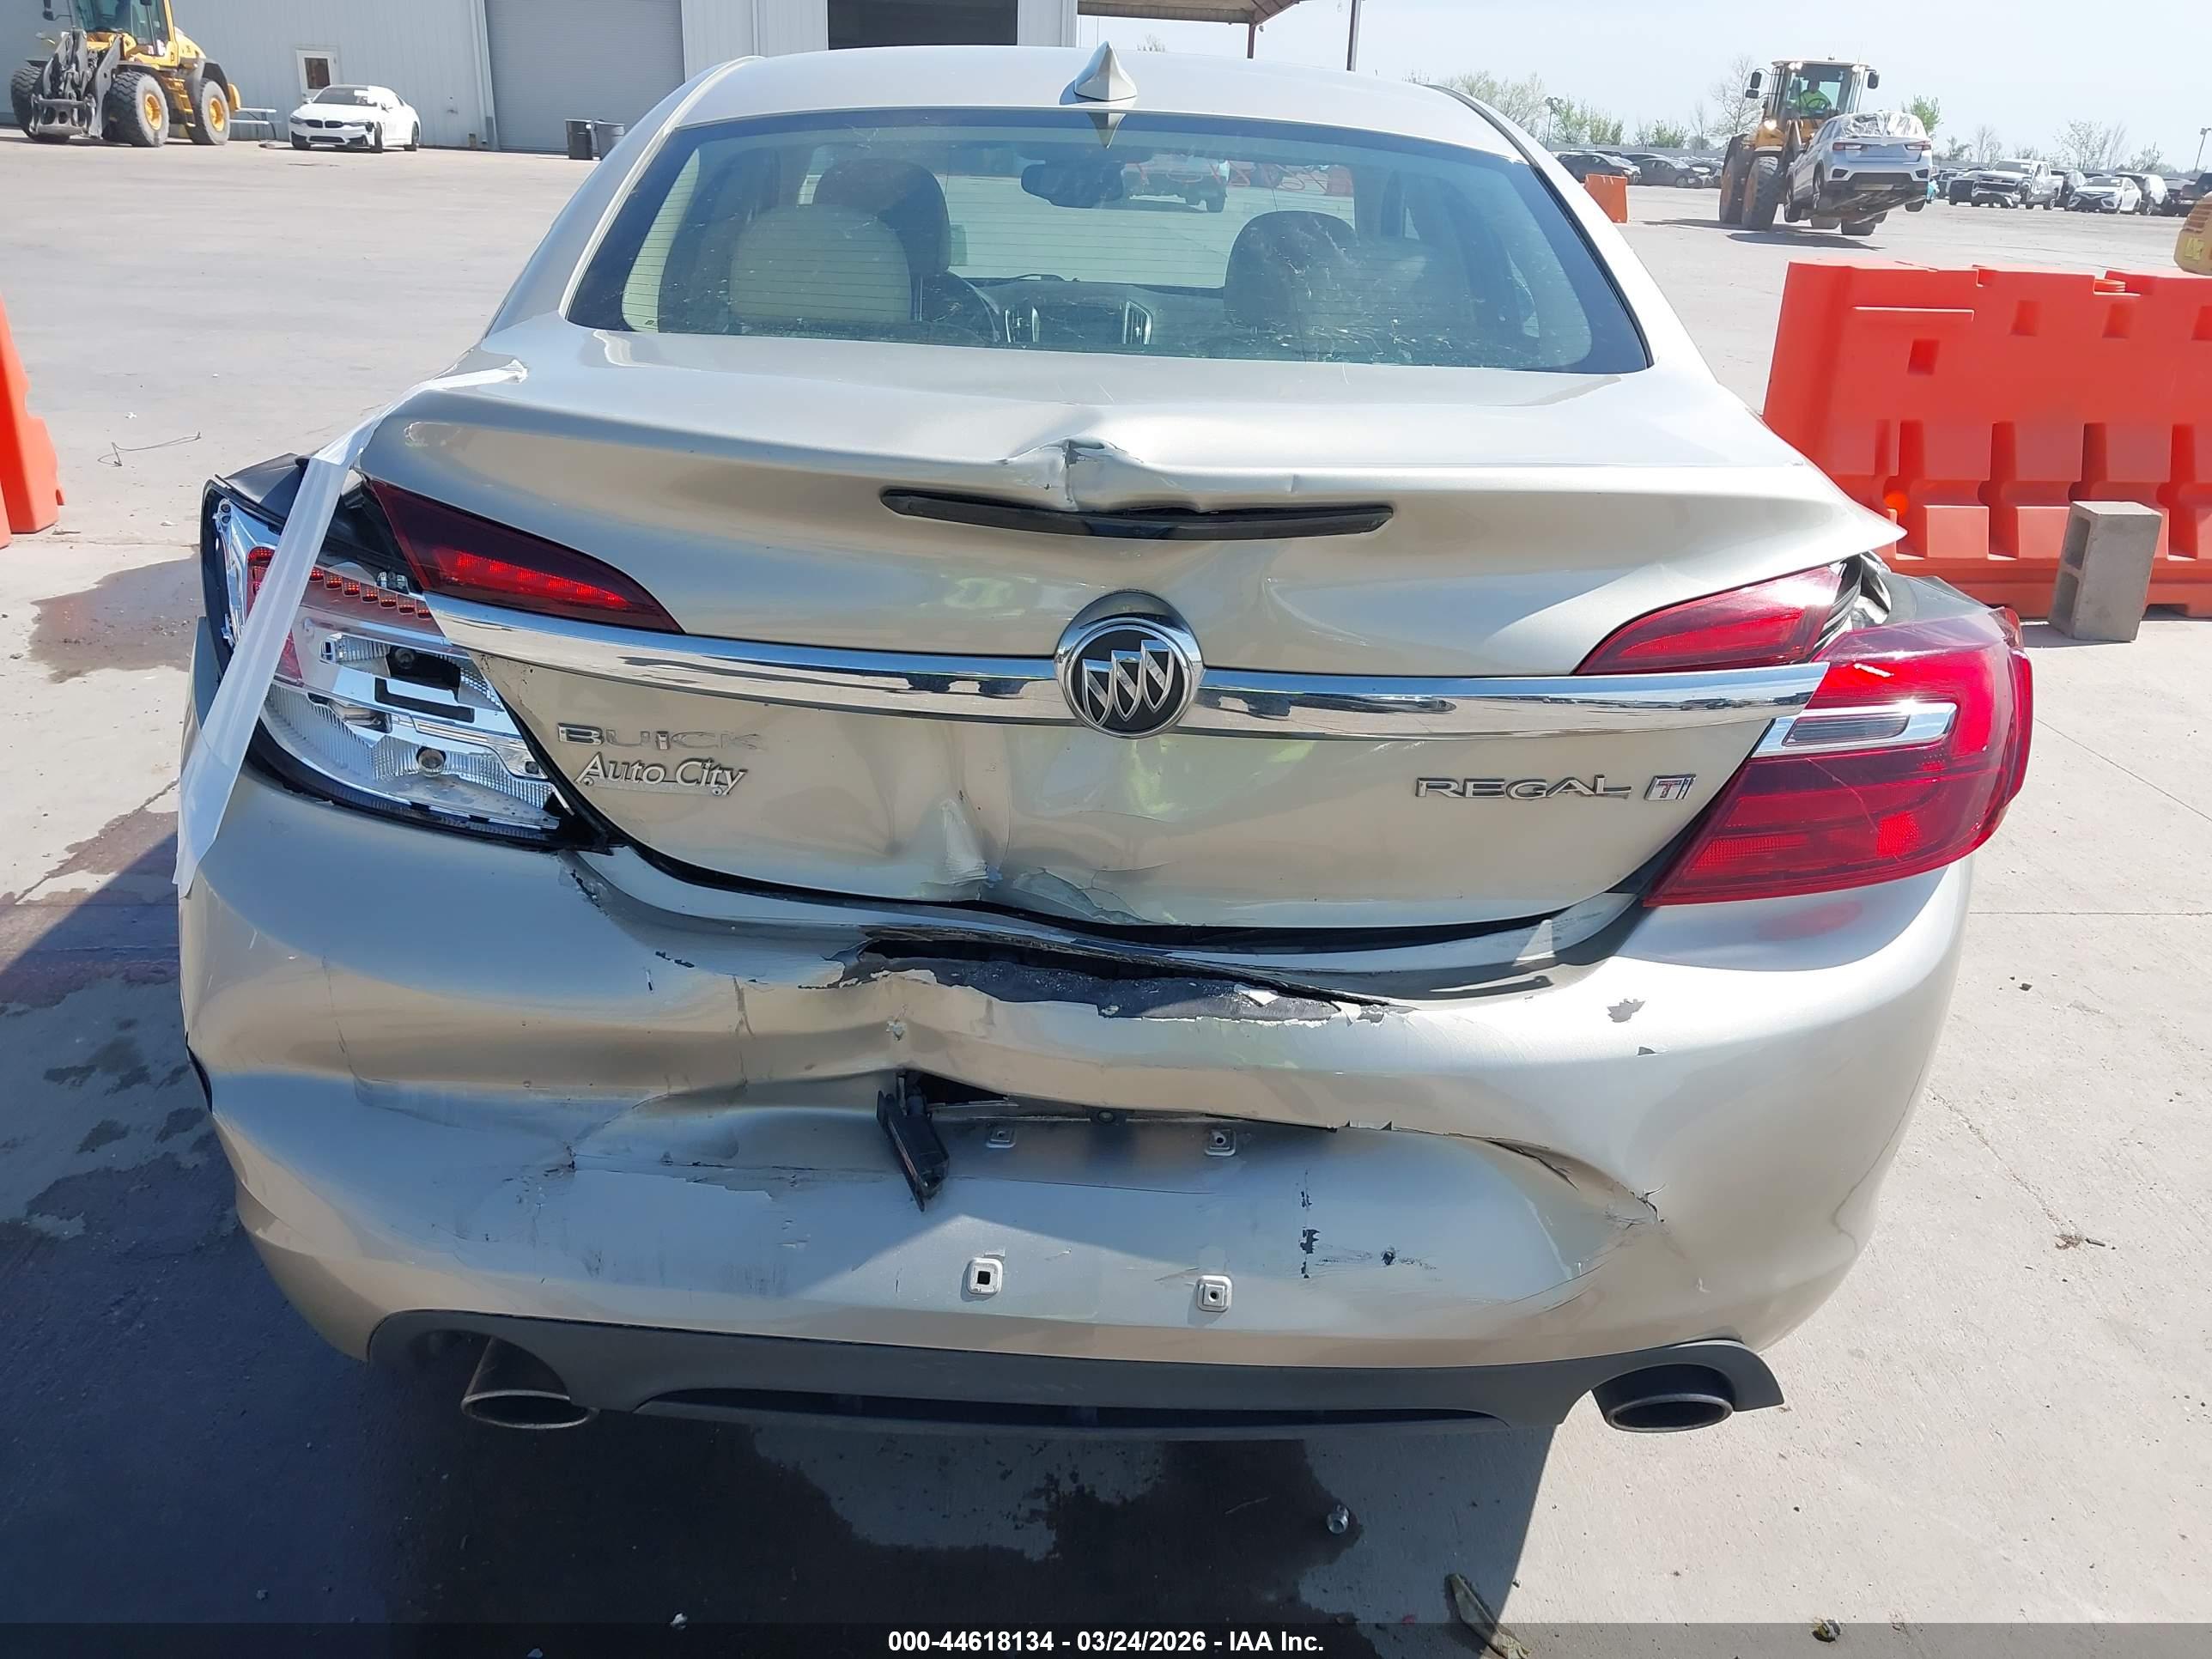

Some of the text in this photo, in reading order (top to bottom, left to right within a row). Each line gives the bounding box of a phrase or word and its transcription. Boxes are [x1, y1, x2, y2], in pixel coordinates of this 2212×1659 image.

[557, 722, 768, 750] BUICK
[574, 751, 749, 796] Auto City
[1415, 775, 1632, 800] REGAL
